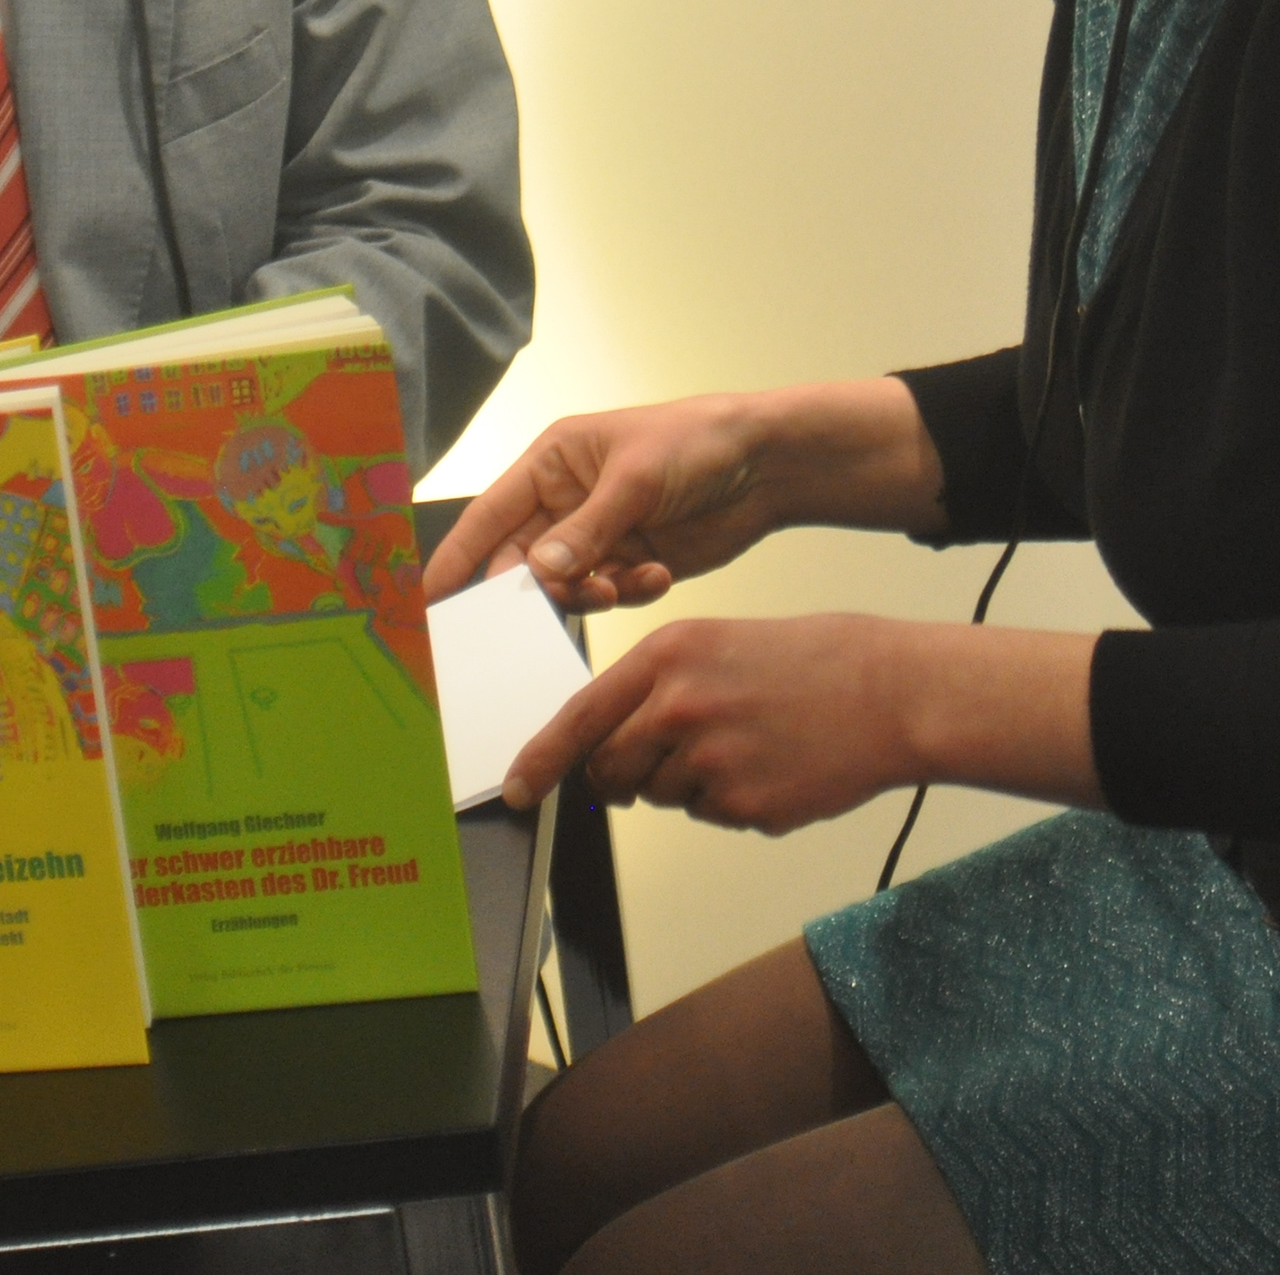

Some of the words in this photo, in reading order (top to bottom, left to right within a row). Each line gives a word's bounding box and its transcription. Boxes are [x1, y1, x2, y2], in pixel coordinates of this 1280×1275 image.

[155, 819, 241, 842] Wolfgang
[154, 849, 245, 877] schwer
[251, 835, 386, 868] erziehbare
[261, 871, 307, 897] des
[311, 866, 344, 892] Dr.
[348, 858, 418, 888] Freud
